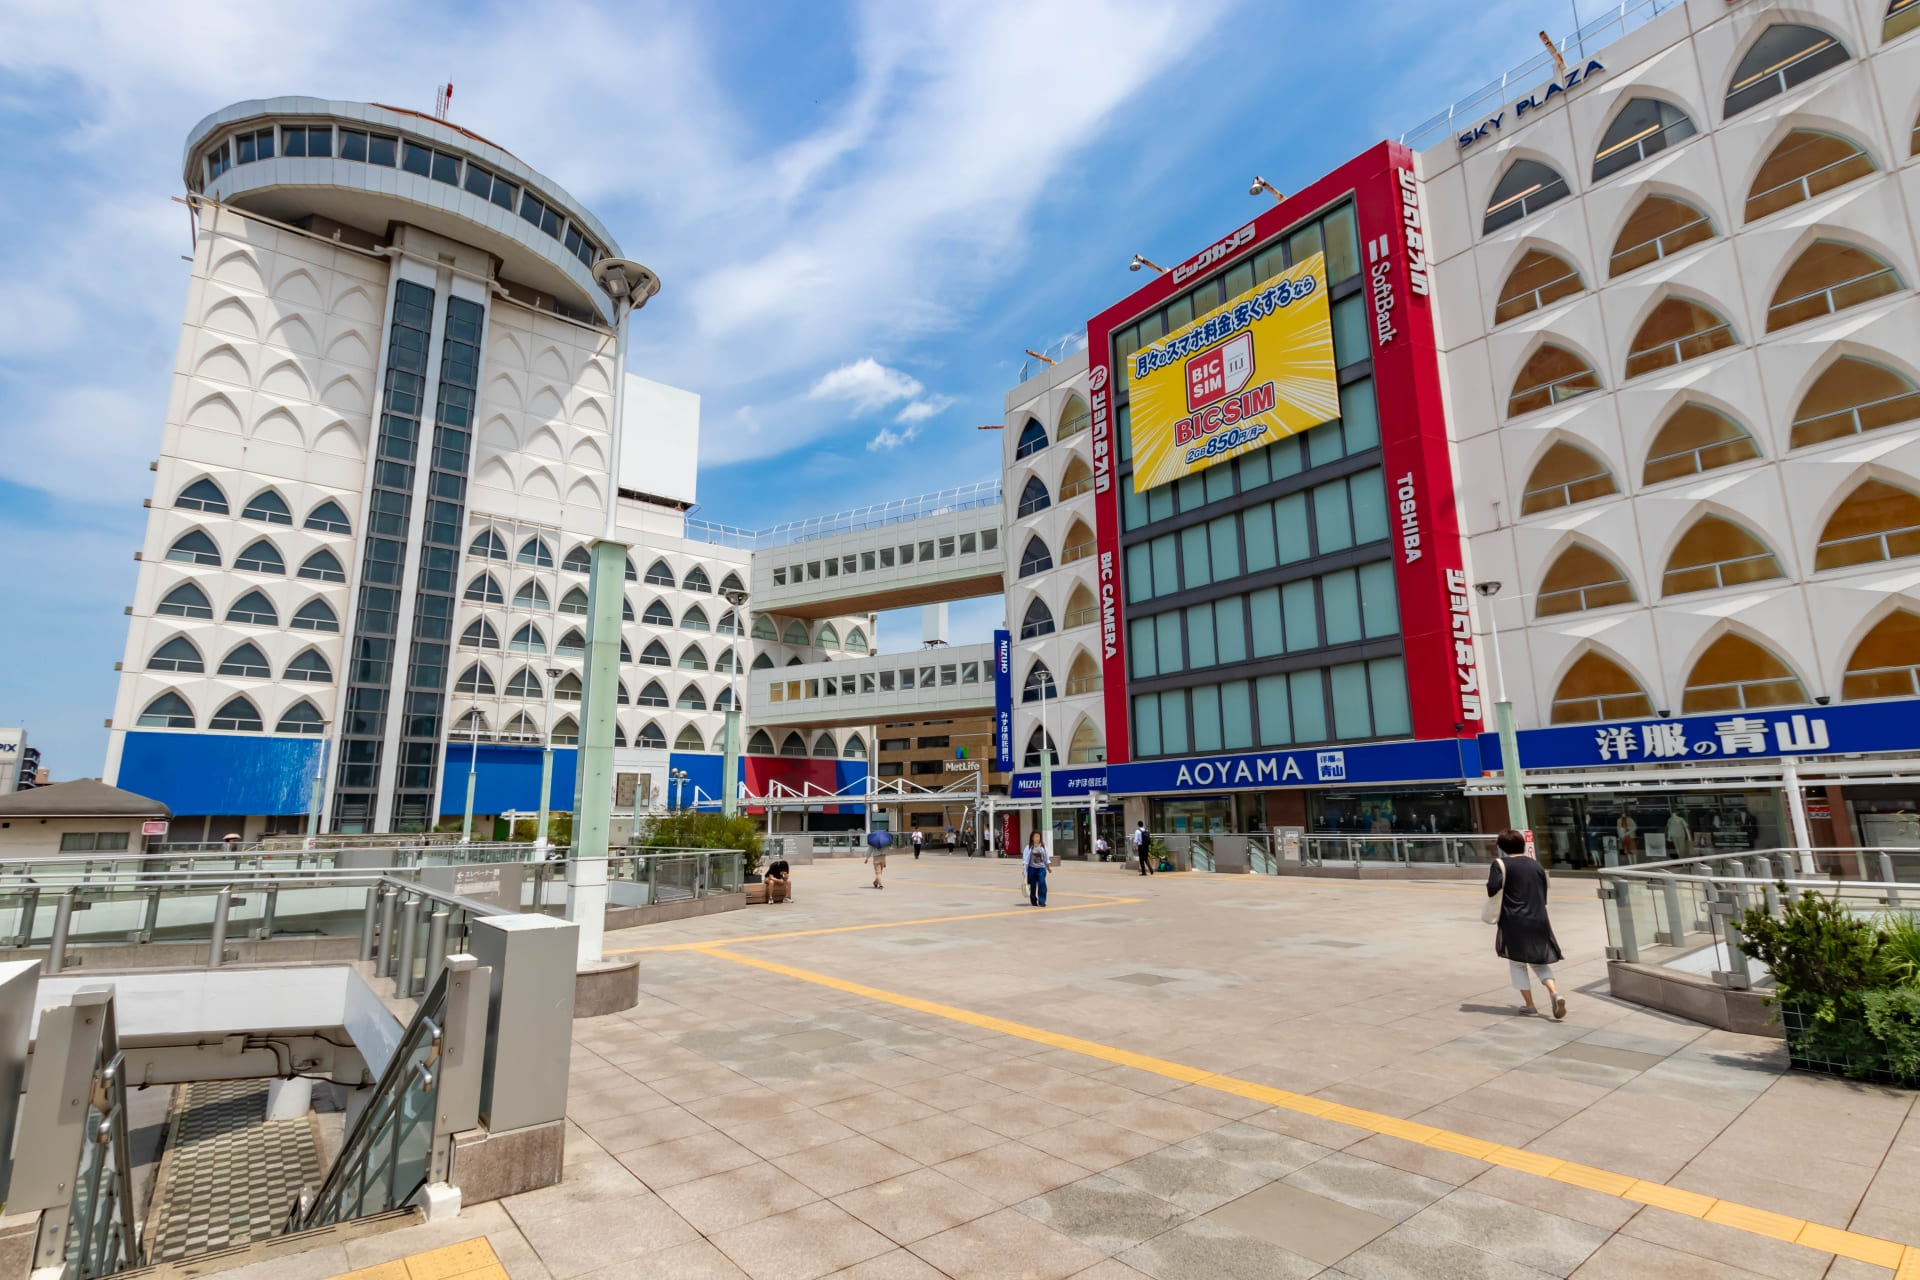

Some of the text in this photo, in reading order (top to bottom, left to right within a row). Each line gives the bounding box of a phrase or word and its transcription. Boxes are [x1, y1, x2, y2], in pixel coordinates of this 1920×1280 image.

[1459, 60, 1604, 148] SKY PLAZA
[1172, 222, 1256, 285] ビックカメラ
[1397, 166, 1430, 297] ビックカメラ
[1371, 261, 1397, 346] SoftBank
[1191, 359, 1221, 384] BIC
[1193, 374, 1222, 398] SIM
[1092, 390, 1110, 494] ビックカメラ
[1397, 472, 1422, 564] TOSHIBA
[1101, 551, 1117, 660] BIC CAMERA
[1446, 568, 1482, 721] ビックカメラ
[945, 761, 980, 772] MetLife
[1176, 756, 1304, 787] AOYAMA
[1594, 714, 1831, 761] 洋服の青山
